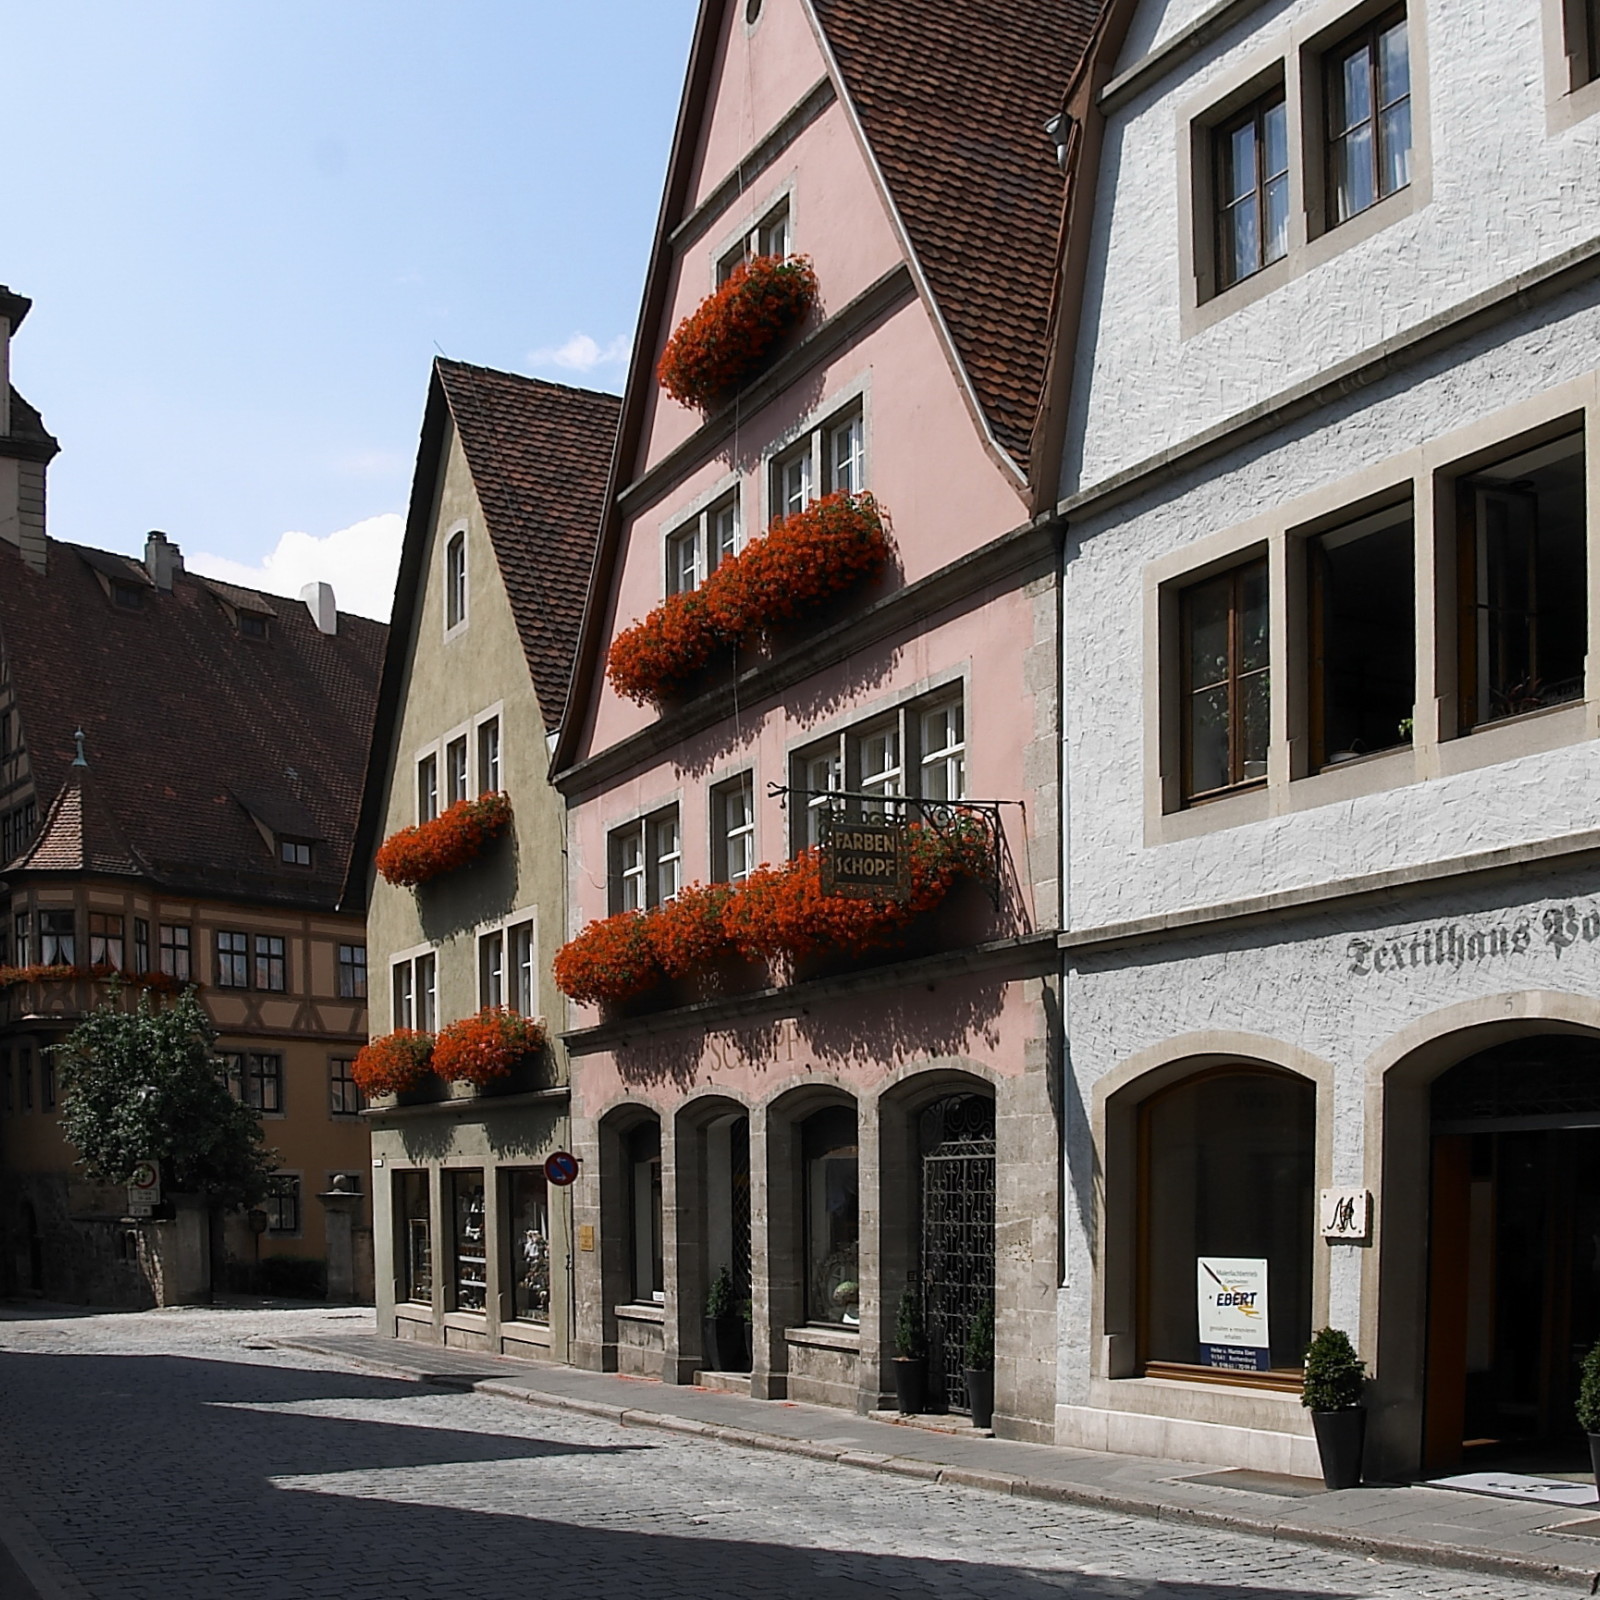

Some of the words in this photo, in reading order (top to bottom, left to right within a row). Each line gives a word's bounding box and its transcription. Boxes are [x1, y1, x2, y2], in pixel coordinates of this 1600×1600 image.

[835, 832, 895, 853] FARBEN
[836, 857, 895, 876] SCHOPF
[1346, 916, 1531, 976] Textilhaus
[1504, 996, 1514, 1014] 5
[710, 1022, 799, 1072] SCPF
[1216, 1292, 1258, 1307] EBERT
